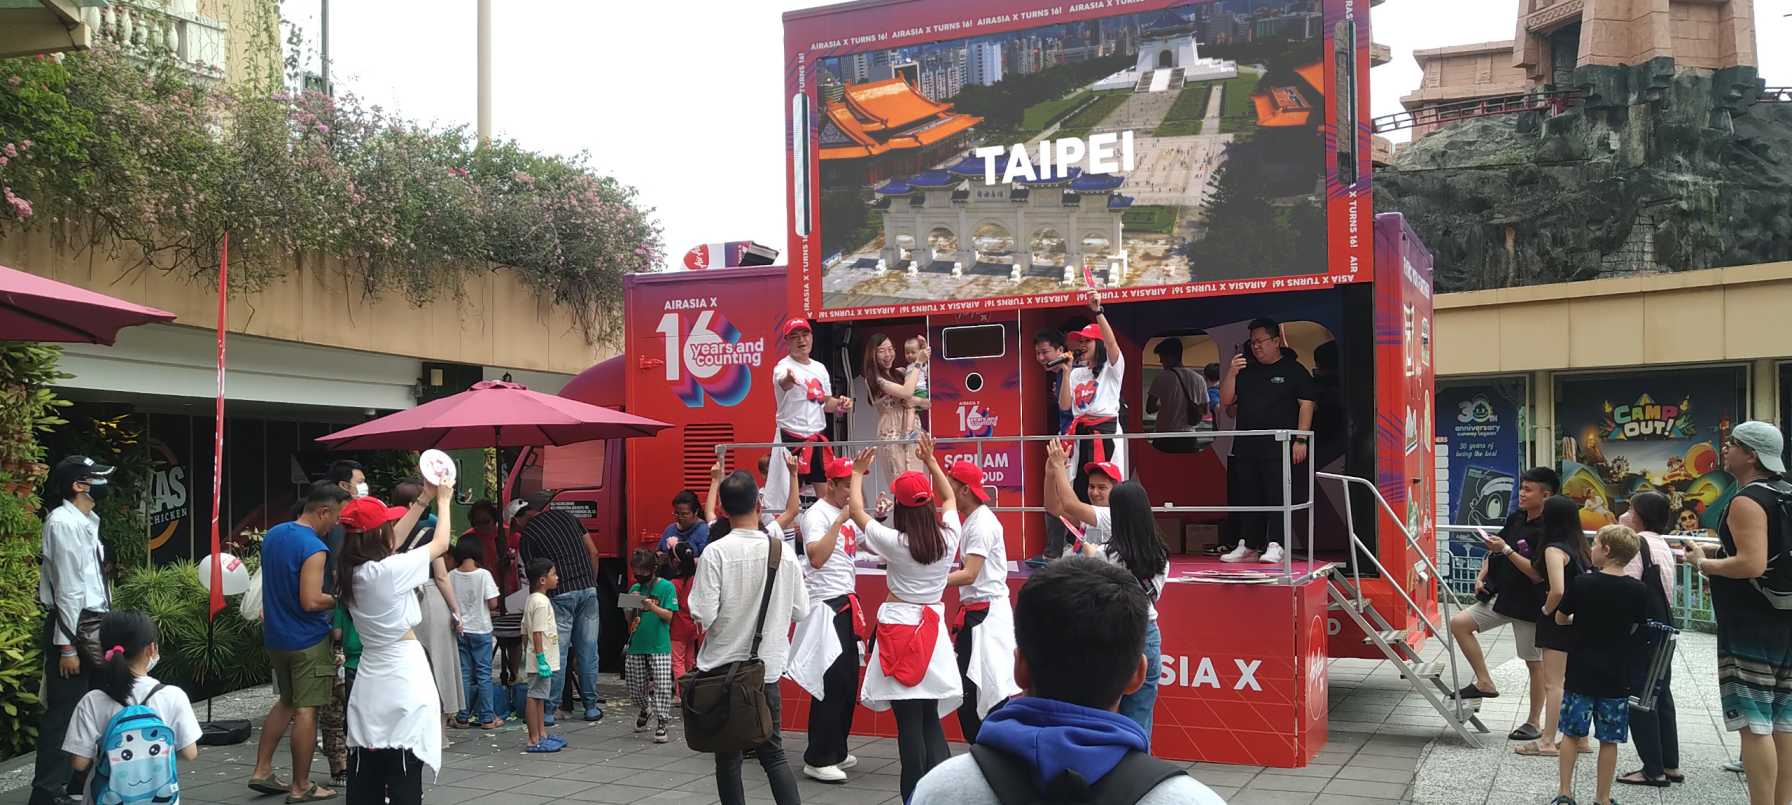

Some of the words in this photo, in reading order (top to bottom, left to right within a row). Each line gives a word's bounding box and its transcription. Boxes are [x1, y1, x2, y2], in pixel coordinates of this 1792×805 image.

[811, 39, 841, 50] AIRASIA
[843, 38, 849, 46] X
[850, 34, 876, 44] TURNS
[878, 32, 888, 41] 16!
[891, 28, 924, 39] AIRASIA
[933, 22, 960, 32] TURNS
[962, 20, 973, 29] 16!
[977, 15, 1011, 26] AIRASIA
[1020, 10, 1049, 19] TURNS
[1051, 6, 1062, 15] 16!
[1069, 2, 1104, 13] AIRASIA
[975, 130, 1135, 186] TAIPEI
[1349, 190, 1357, 198] X
[1348, 200, 1358, 233] TURNS
[1349, 235, 1358, 248] 16!
[1228, 280, 1267, 290] AIRASIA
[1272, 280, 1285, 288] 16!
[1287, 277, 1320, 287] TURNS
[1322, 276, 1329, 284] X
[1171, 287, 1183, 295] 16!
[1185, 284, 1217, 294] TURNS
[1219, 283, 1226, 291] X
[1121, 290, 1128, 298] X
[1130, 288, 1167, 297] AIRASIA
[664, 298, 707, 310] AIRASIA
[710, 297, 718, 307] X
[984, 300, 996, 308] 16!
[996, 298, 1025, 307] TURNS
[1035, 294, 1069, 304] AIRASIA
[911, 304, 937, 312] TURNS
[939, 303, 946, 311] X
[947, 301, 980, 310] AIRASIA
[830, 309, 856, 318] TURNS
[864, 307, 896, 315] AIRASIA
[656, 310, 723, 380] 16
[691, 343, 733, 359] years
[736, 337, 764, 352] and
[697, 350, 761, 366] counting
[956, 405, 982, 431] 16
[1614, 404, 1678, 424] CAMP
[1624, 418, 1674, 437] OUT!
[982, 471, 1004, 482] OUD
[1328, 617, 1341, 636] D
[1158, 655, 1220, 689] SIA
[1233, 658, 1263, 692] X
